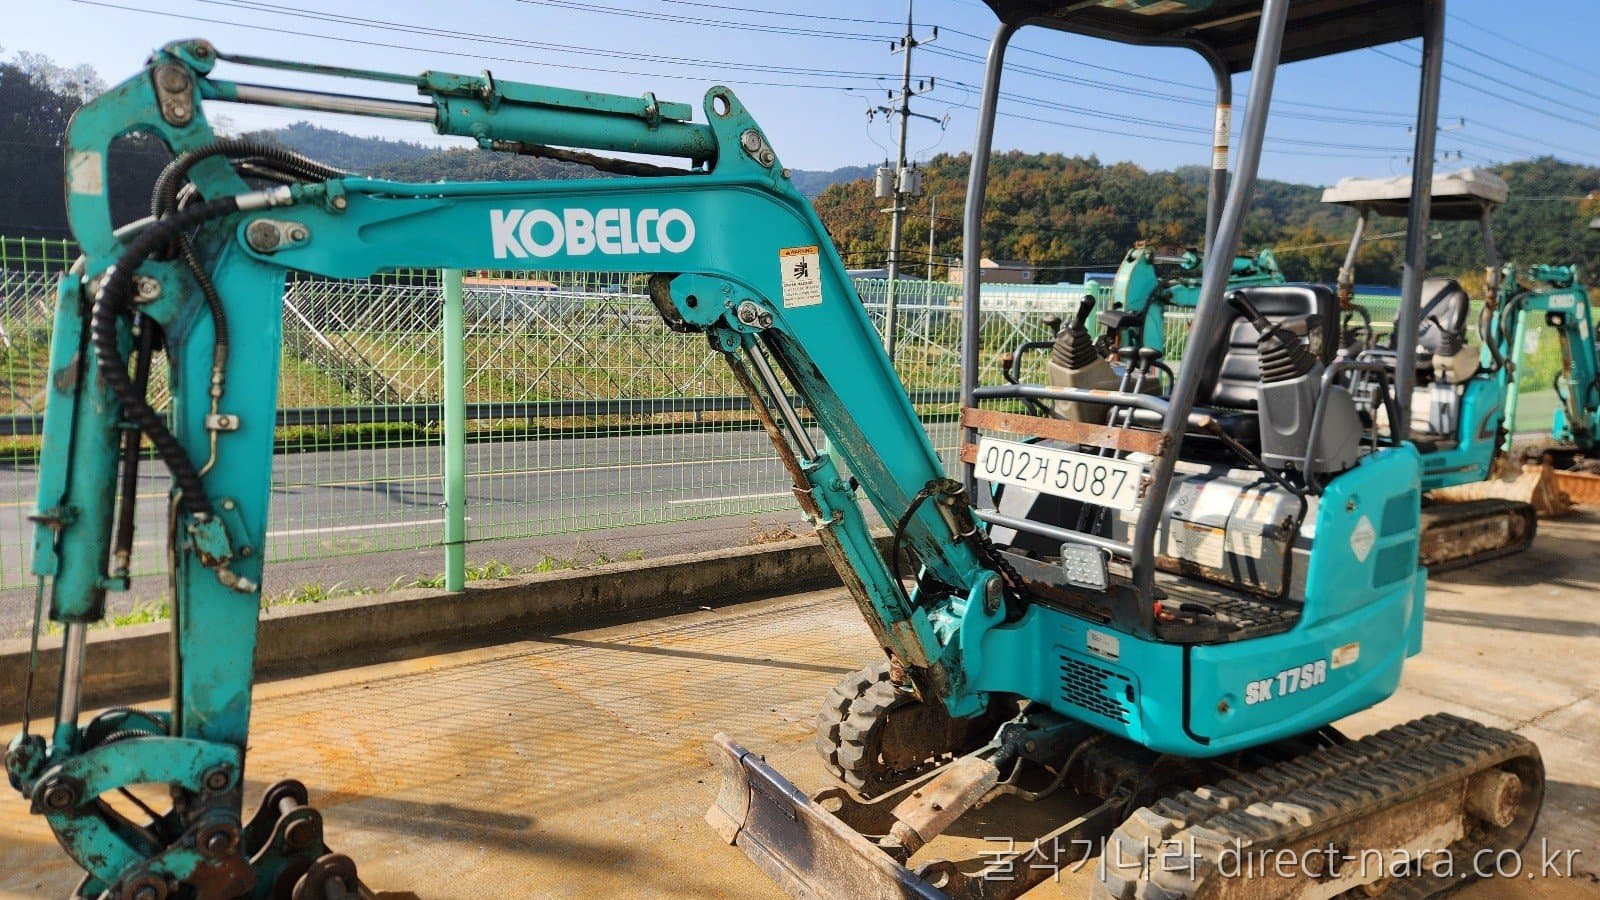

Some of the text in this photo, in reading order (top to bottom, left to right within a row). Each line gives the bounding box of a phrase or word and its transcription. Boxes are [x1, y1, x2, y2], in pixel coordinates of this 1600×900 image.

[490, 208, 695, 259] KOBELCO
[1245, 660, 1327, 705] SK 17SR
